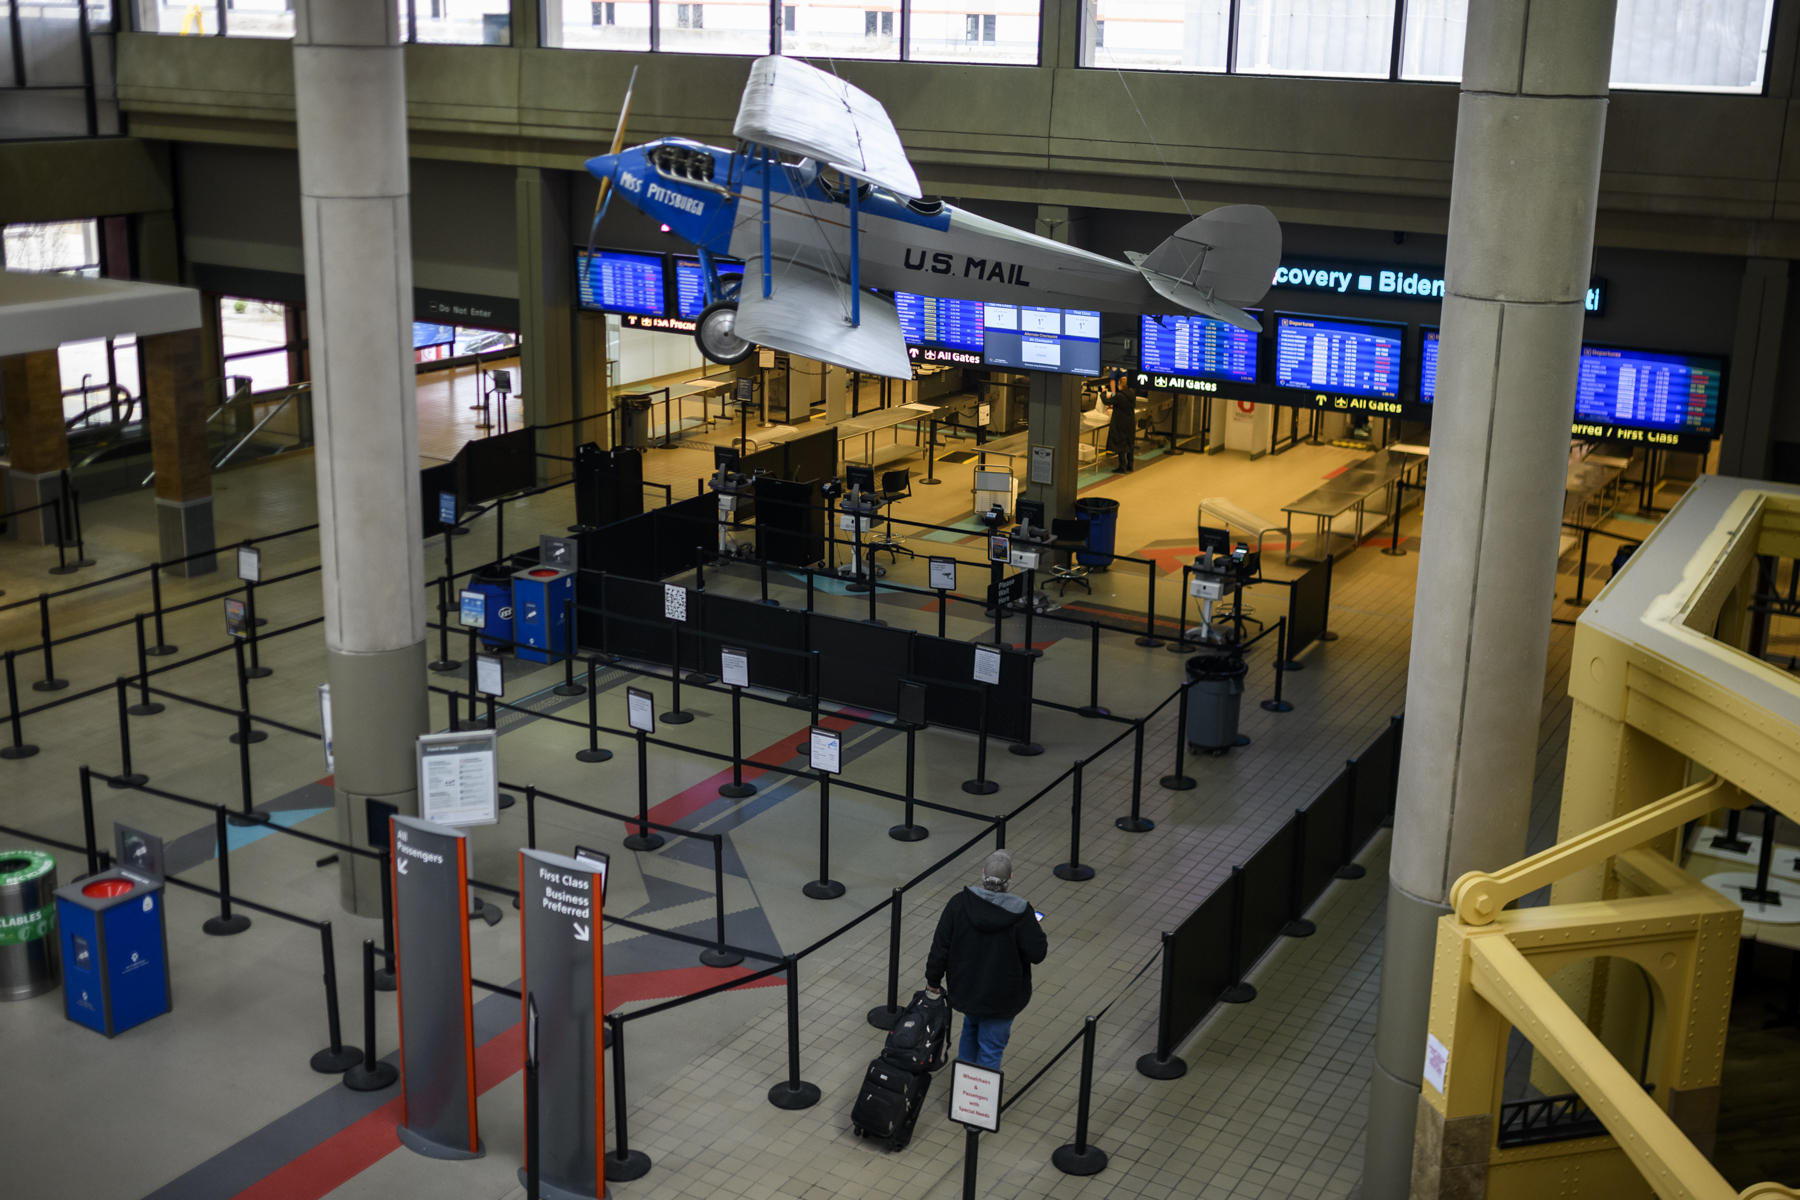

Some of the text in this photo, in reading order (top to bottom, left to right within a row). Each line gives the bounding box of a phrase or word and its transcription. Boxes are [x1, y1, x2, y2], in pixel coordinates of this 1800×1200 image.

[647, 183, 704, 216] PITTSBURGH
[904, 248, 1030, 287] U.S. MAIL
[439, 304, 492, 318] Do Not Enter
[937, 351, 951, 360] All
[952, 352, 980, 364] Gates
[1169, 378, 1217, 392] All Gates
[1350, 399, 1402, 413] All Gates
[1571, 424, 1602, 436] erred
[1617, 428, 1644, 441] First
[1648, 431, 1679, 444] Class
[998, 579, 1014, 589] Please
[397, 830, 408, 842] All
[397, 841, 443, 864] Passengers
[540, 867, 589, 890] First Class
[546, 886, 589, 906] Business
[543, 898, 589, 918] Preferred
[0, 912, 42, 927] LABLES
[963, 1073, 990, 1085] Wheelchairs
[963, 1090, 988, 1101] Passengers
[959, 1106, 975, 1115] Special
